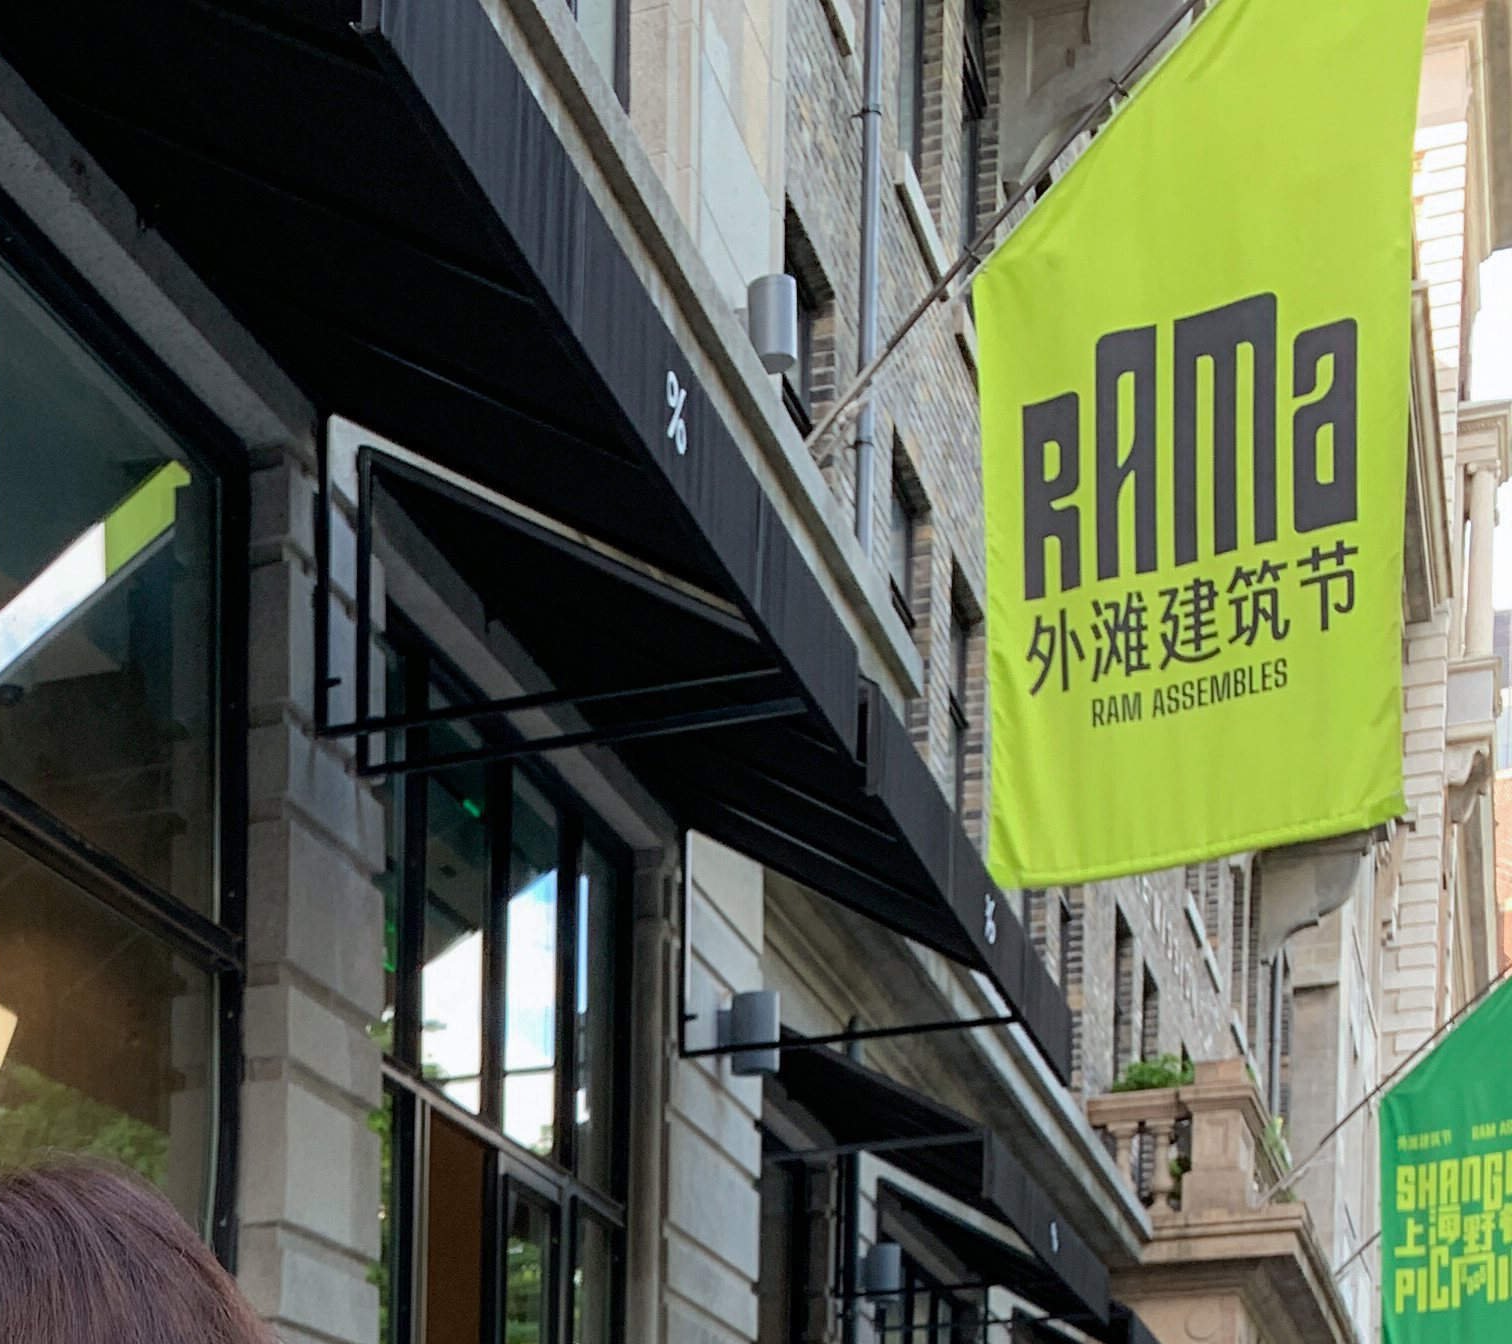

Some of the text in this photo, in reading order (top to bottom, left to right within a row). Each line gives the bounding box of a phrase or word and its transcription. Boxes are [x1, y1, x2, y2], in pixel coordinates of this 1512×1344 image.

[1026, 540, 1359, 697] 外滩建筑节
[1091, 656, 1288, 728] RAM ASSEMBLES
